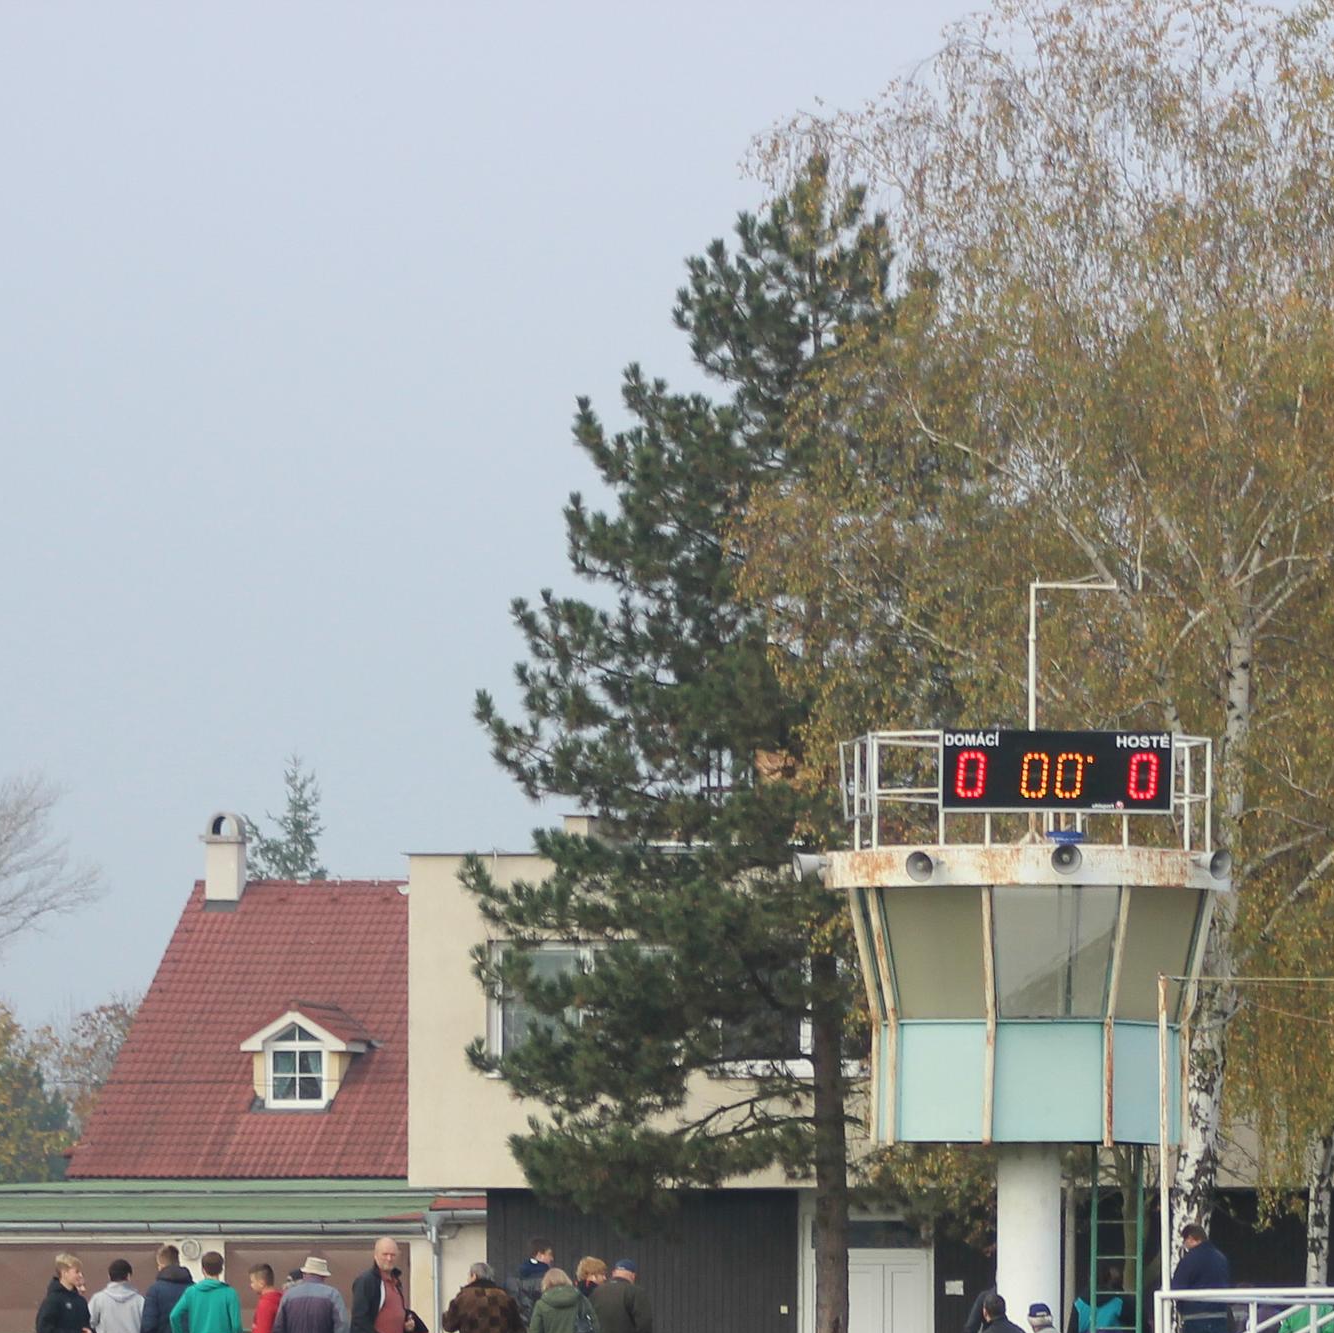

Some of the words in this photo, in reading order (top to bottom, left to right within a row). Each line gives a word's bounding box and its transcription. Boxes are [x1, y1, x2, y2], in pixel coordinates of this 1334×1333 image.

[944, 731, 1000, 747] DOMÁCÍ
[1116, 732, 1171, 749] HOSTÉ
[955, 751, 987, 798] 0
[1128, 752, 1159, 800] 0
